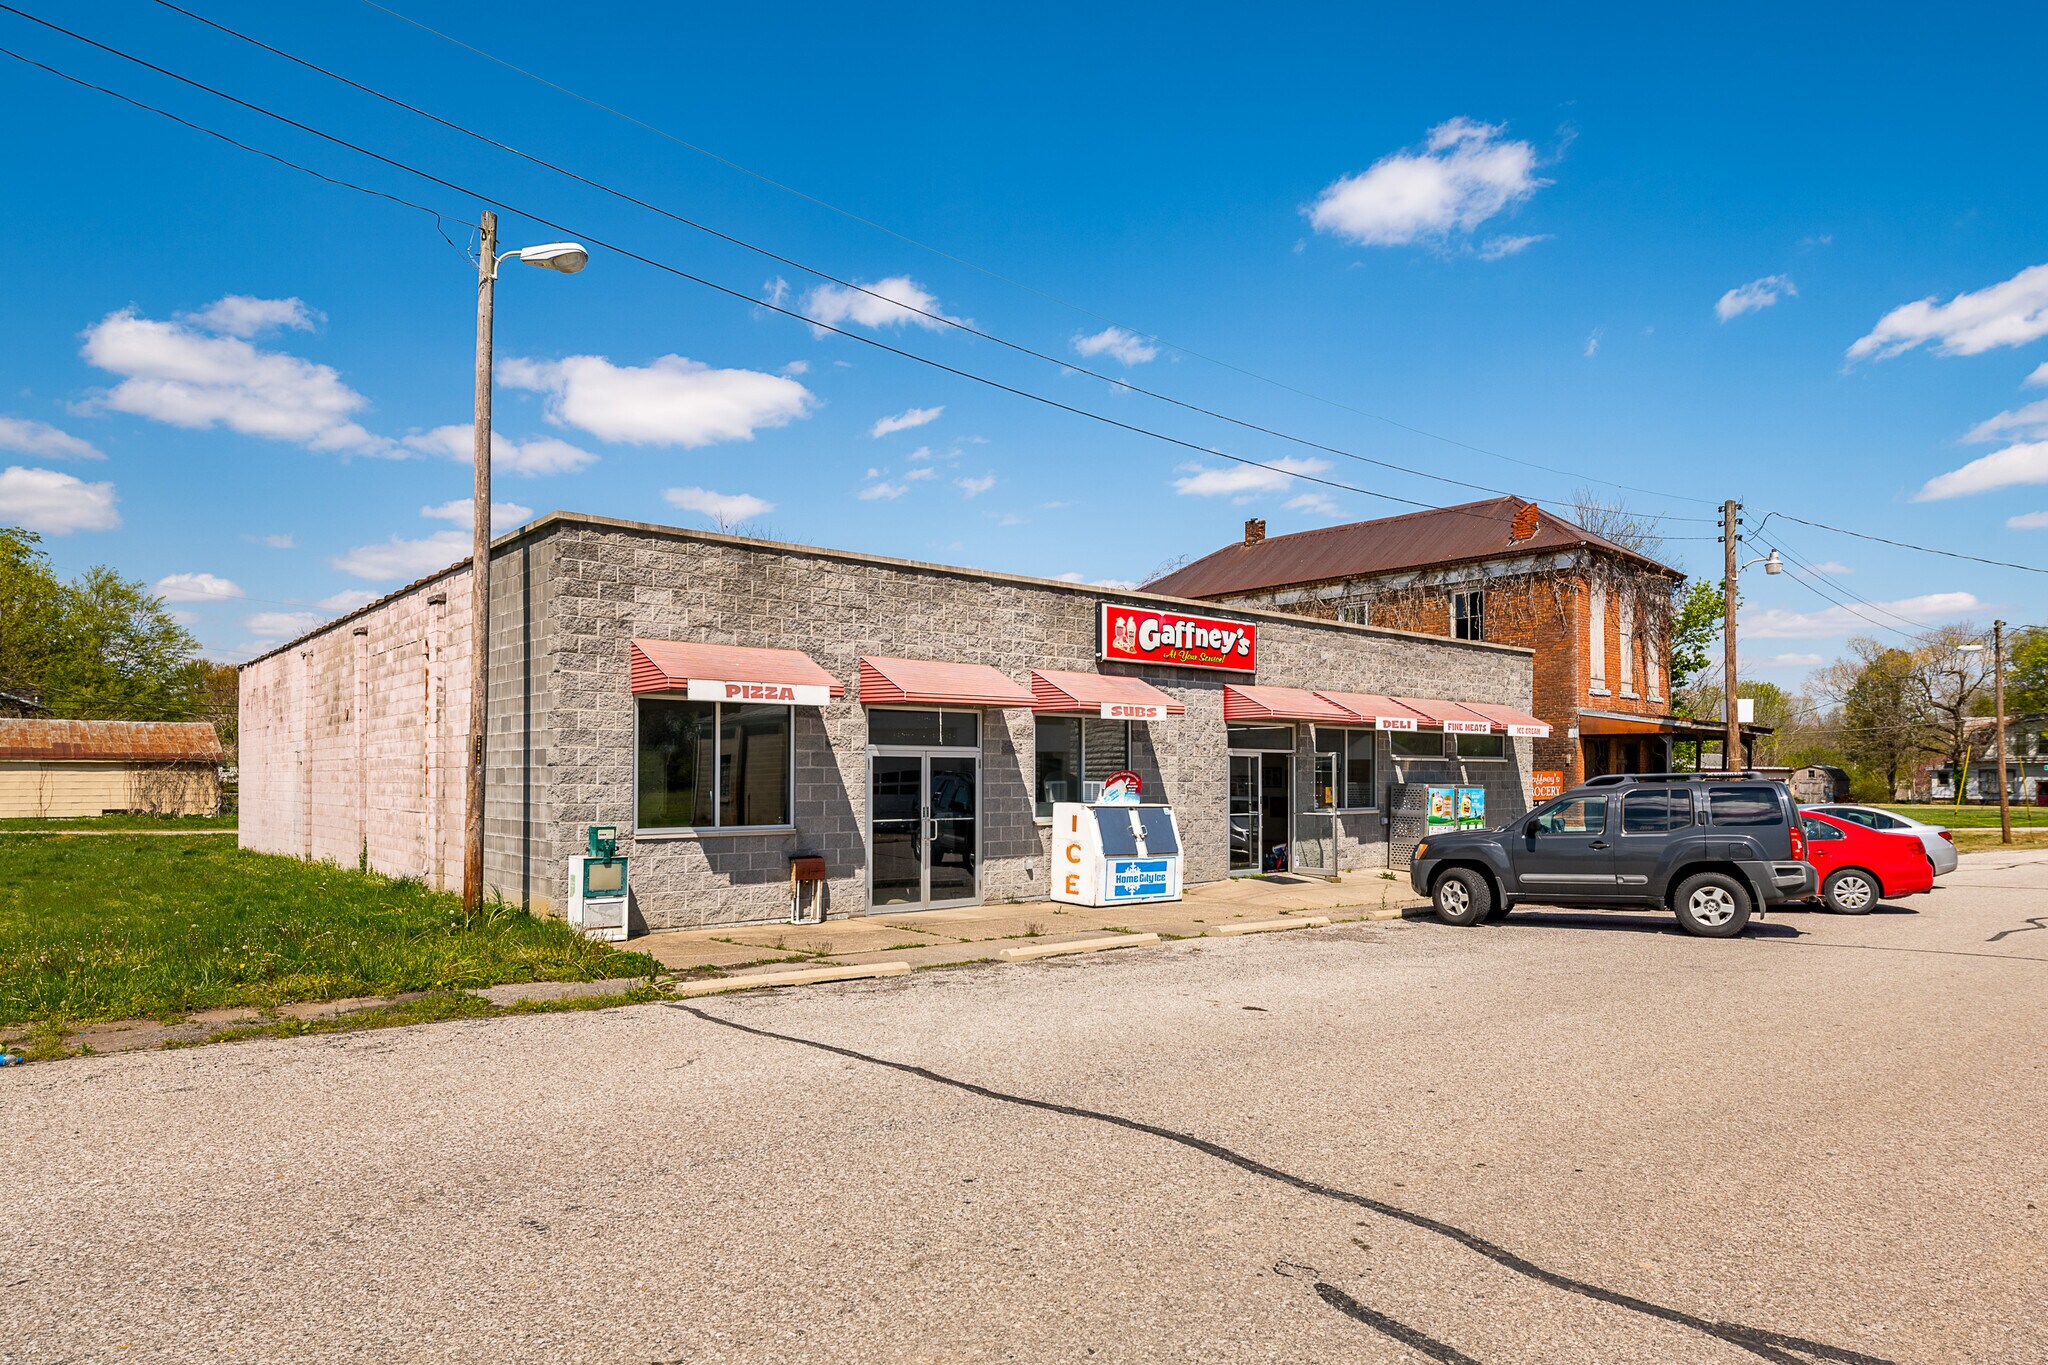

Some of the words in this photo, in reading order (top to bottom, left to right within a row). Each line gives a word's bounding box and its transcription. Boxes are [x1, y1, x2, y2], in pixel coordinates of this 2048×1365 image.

[1139, 618, 1251, 656] Gaffney's
[1178, 650, 1198, 662] Your
[725, 684, 796, 701] PIZZA
[1111, 705, 1157, 718] SUBS
[1382, 719, 1412, 729] DELI
[1447, 722, 1464, 731] FINE
[1464, 723, 1487, 732] MEATS
[1516, 727, 1524, 735] ICE
[1525, 727, 1541, 735] CREAM
[1532, 773, 1560, 785] affney's
[1065, 814, 1082, 895] ICE
[1115, 875, 1139, 883] Home
[1140, 873, 1154, 883] City
[1154, 873, 1166, 882] Ice
